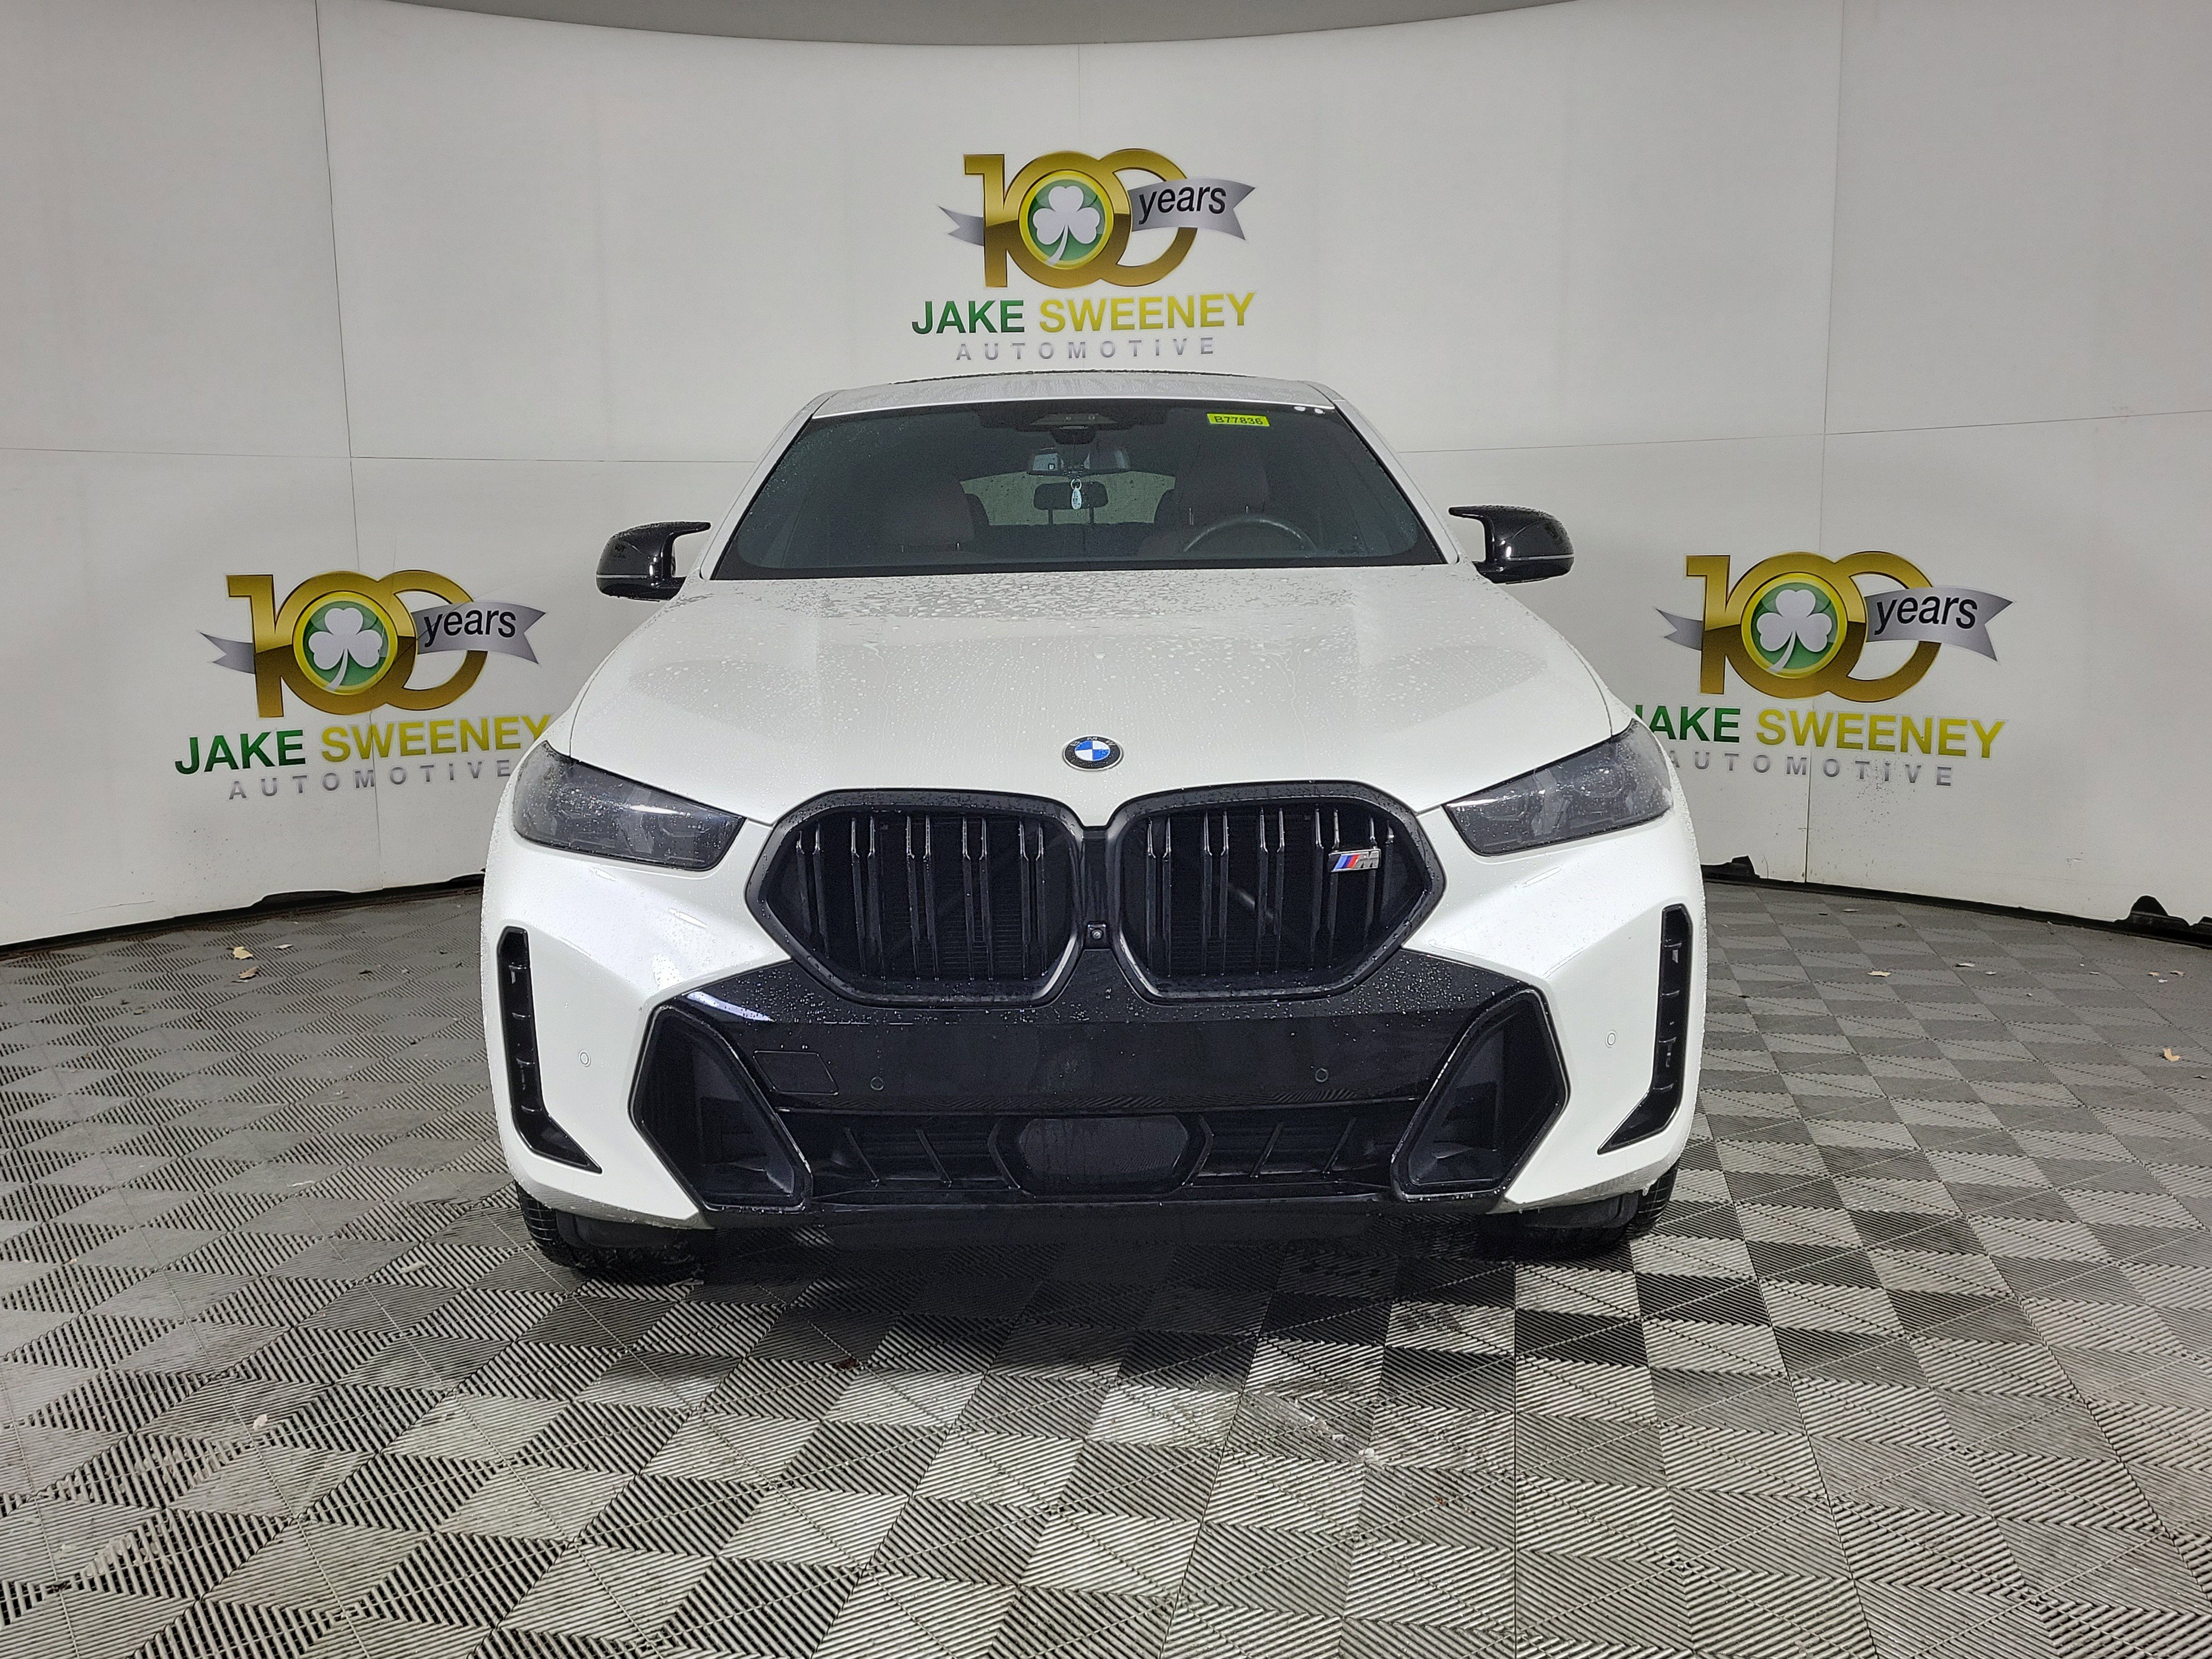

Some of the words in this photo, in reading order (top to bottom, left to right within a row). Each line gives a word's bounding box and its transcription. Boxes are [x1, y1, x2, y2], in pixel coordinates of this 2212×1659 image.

[963, 148, 1198, 289] 100
[1138, 186, 1226, 225] years
[912, 300, 1025, 335] JAKE
[1039, 292, 1255, 333] SWEENEY
[956, 337, 1214, 361] AUTOMOTIVE
[1214, 415, 1263, 425] B77836
[424, 609, 516, 647] years
[1686, 551, 1942, 703] 100
[1874, 595, 1978, 635] years
[225, 570, 488, 719] 100
[175, 730, 306, 775] JAKE
[321, 714, 551, 763] SWEENEY
[1070, 736, 1116, 747] BMW
[1756, 708, 2004, 759] SWEENEY
[229, 760, 510, 800] AUTOMOTIVE
